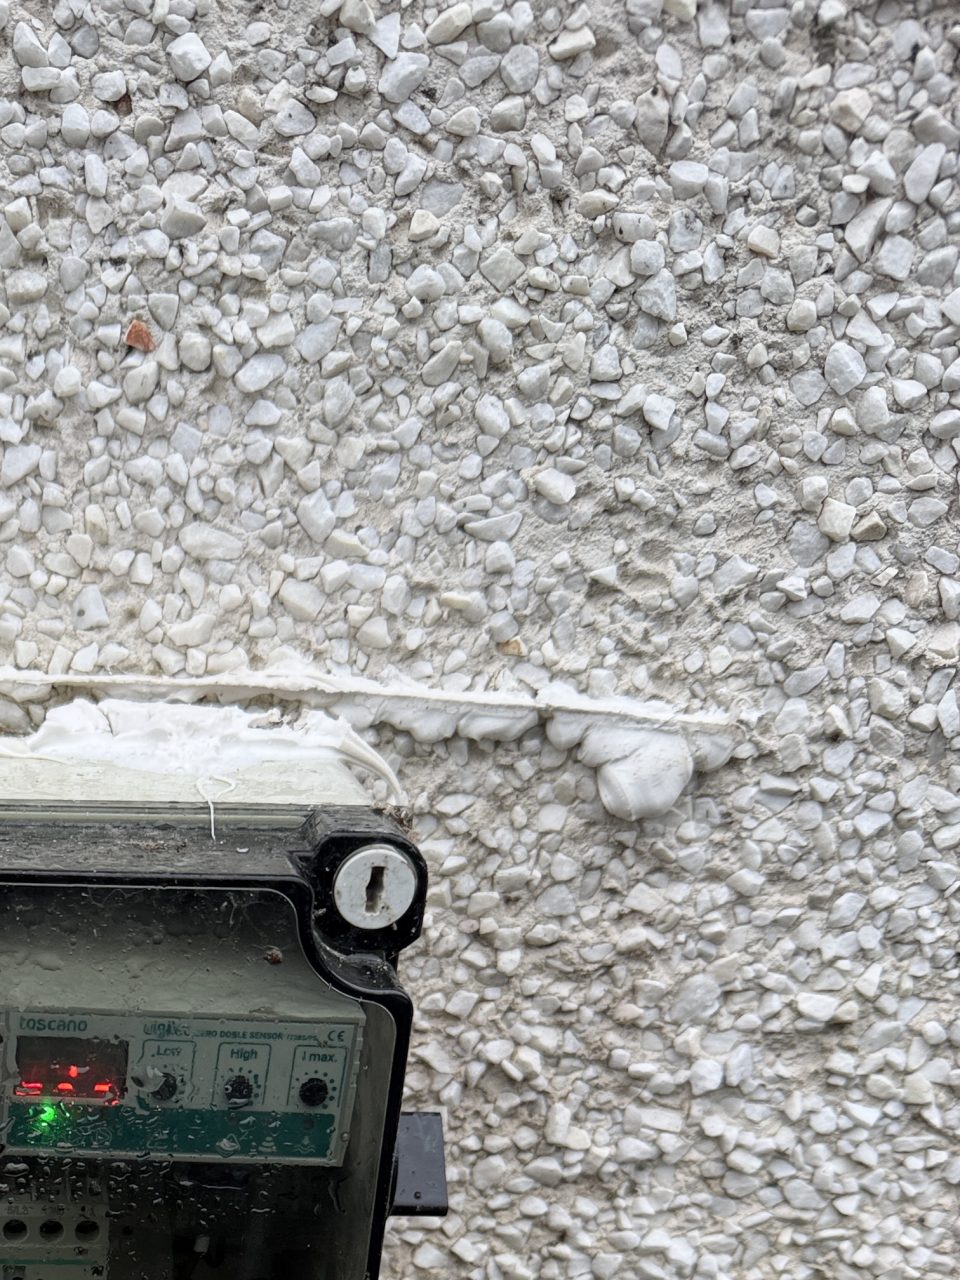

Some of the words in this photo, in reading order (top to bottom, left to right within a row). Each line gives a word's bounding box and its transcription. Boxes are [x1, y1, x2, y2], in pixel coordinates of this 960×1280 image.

[19, 1015, 88, 1033] toscano
[249, 1031, 284, 1043] SENSOR
[230, 1047, 258, 1061] High
